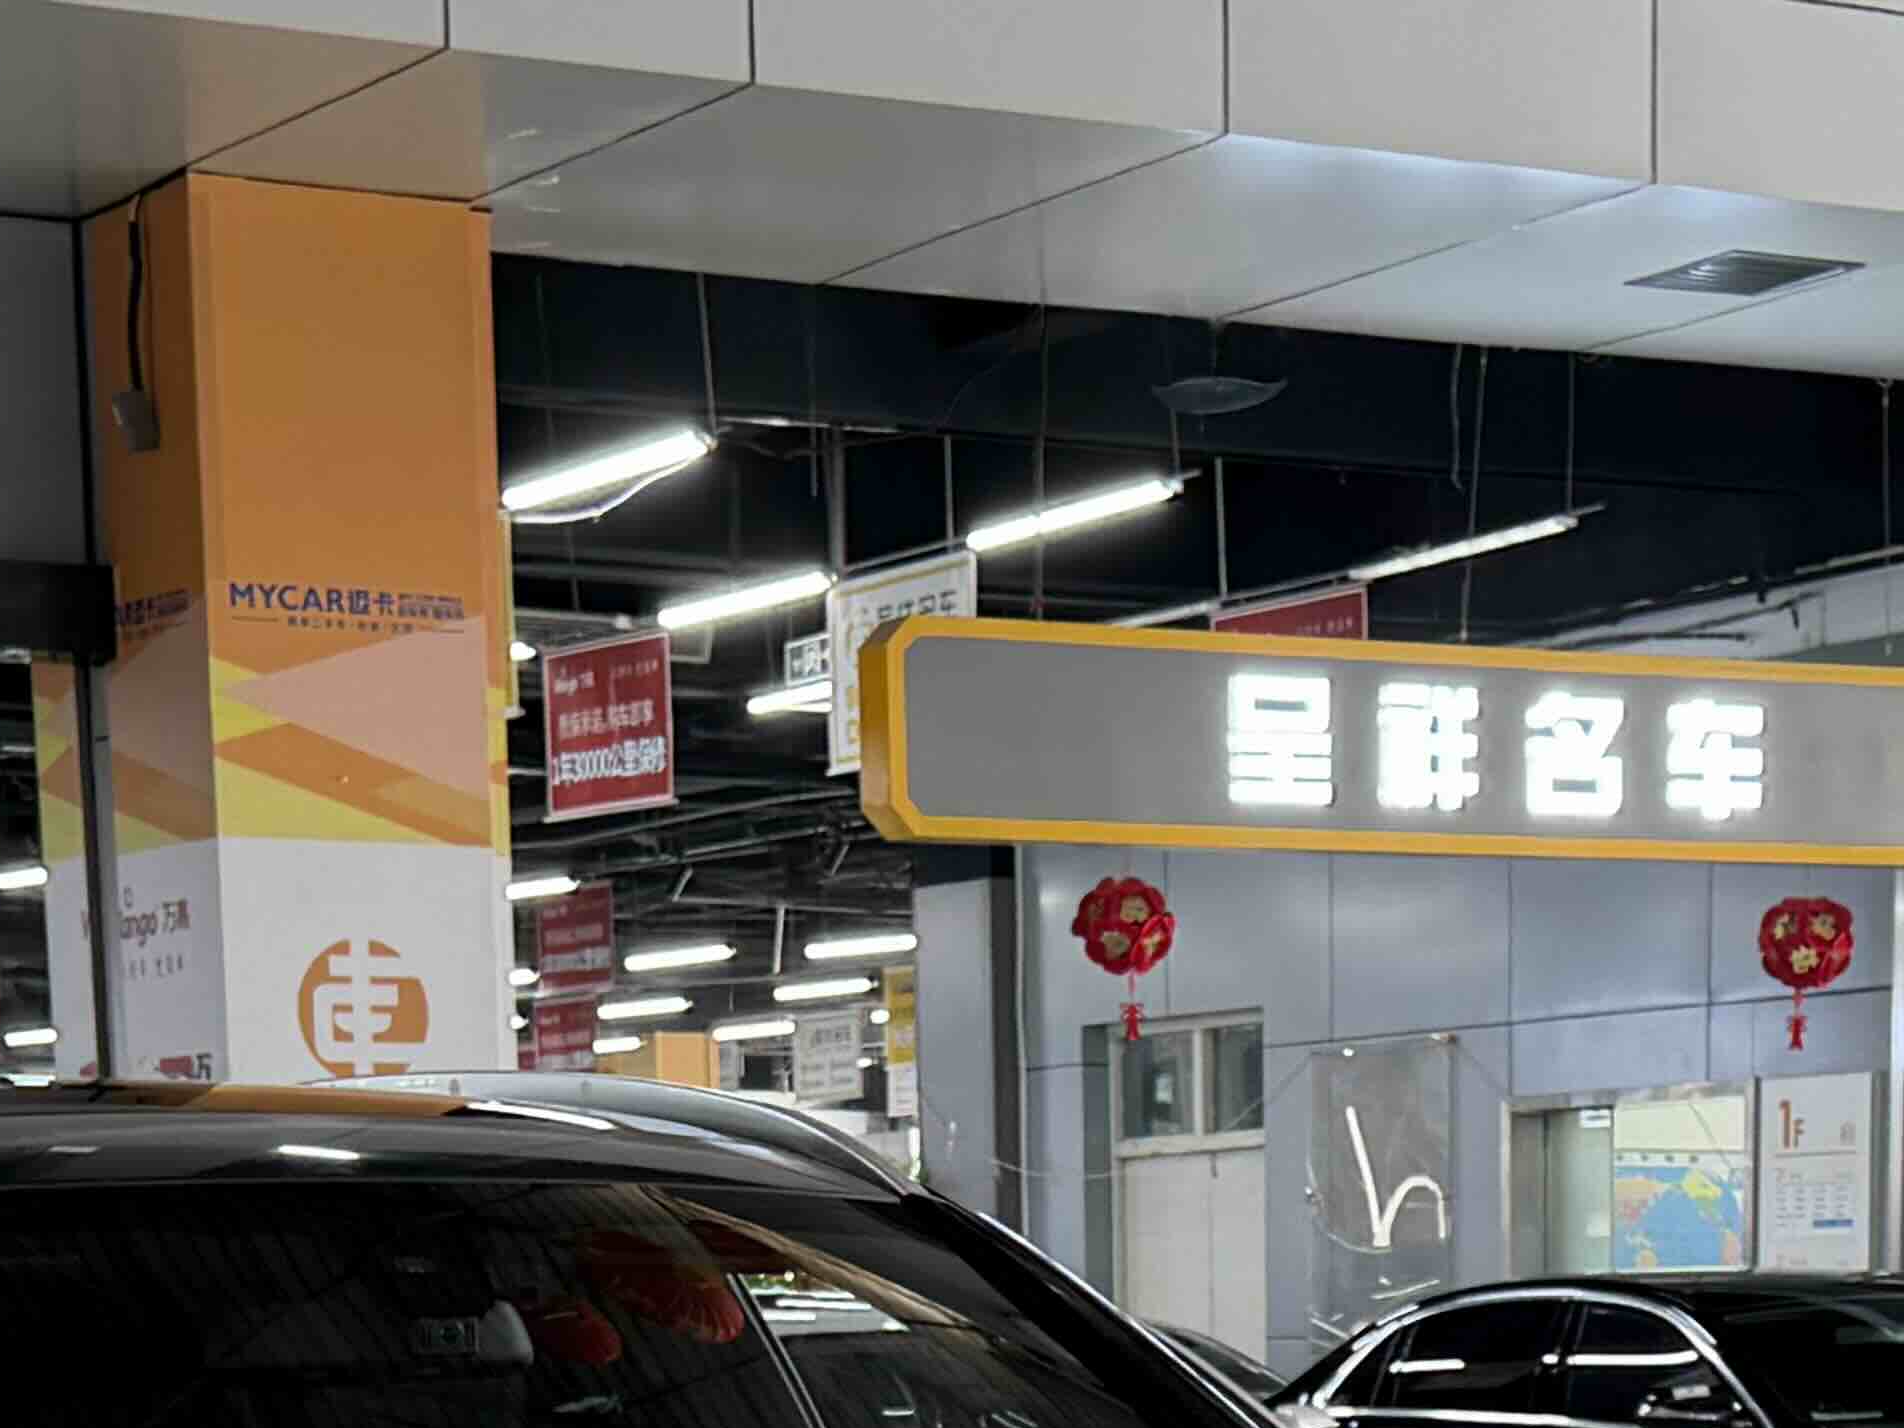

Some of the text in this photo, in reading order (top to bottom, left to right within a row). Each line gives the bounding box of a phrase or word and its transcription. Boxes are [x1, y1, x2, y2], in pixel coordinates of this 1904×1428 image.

[1227, 672, 1765, 822] 呈祥名车
[120, 904, 157, 948] ango
